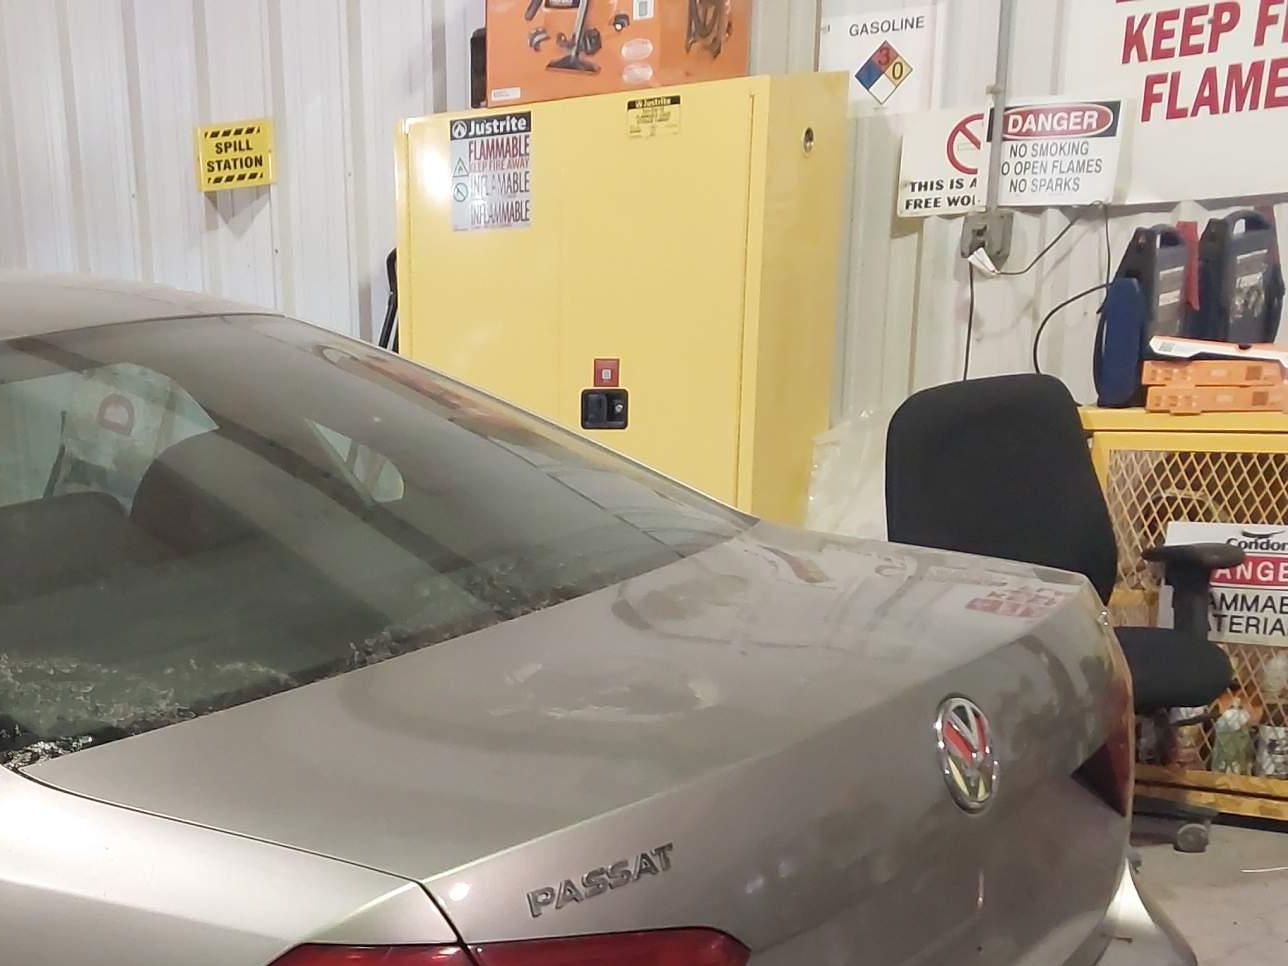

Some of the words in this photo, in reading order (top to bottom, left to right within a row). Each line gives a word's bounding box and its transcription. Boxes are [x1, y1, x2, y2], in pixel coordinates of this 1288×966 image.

[849, 16, 925, 36] GASOLINE
[1122, 2, 1240, 64] KEEP
[878, 47, 890, 66] 3
[892, 61, 903, 80] 0
[1141, 58, 1288, 122] FLAME
[469, 116, 527, 136] Justrite
[1008, 111, 1099, 133] DANGER
[215, 139, 253, 154] SPILL
[469, 135, 530, 161] FLAMMABLE
[1009, 144, 1027, 158] NO
[1031, 142, 1089, 157] SMOKING
[207, 155, 263, 172] STATION
[507, 156, 529, 169] AWAY
[1014, 161, 1047, 175] OPEN
[1051, 158, 1102, 174] FLAMES
[910, 180, 944, 192] THIS
[949, 178, 965, 190] IS
[1009, 179, 1027, 193] NO
[1031, 177, 1080, 192] SPARKS
[905, 197, 942, 210] FREE
[1215, 560, 1288, 582] ANGE
[526, 842, 673, 918] PASSAT
